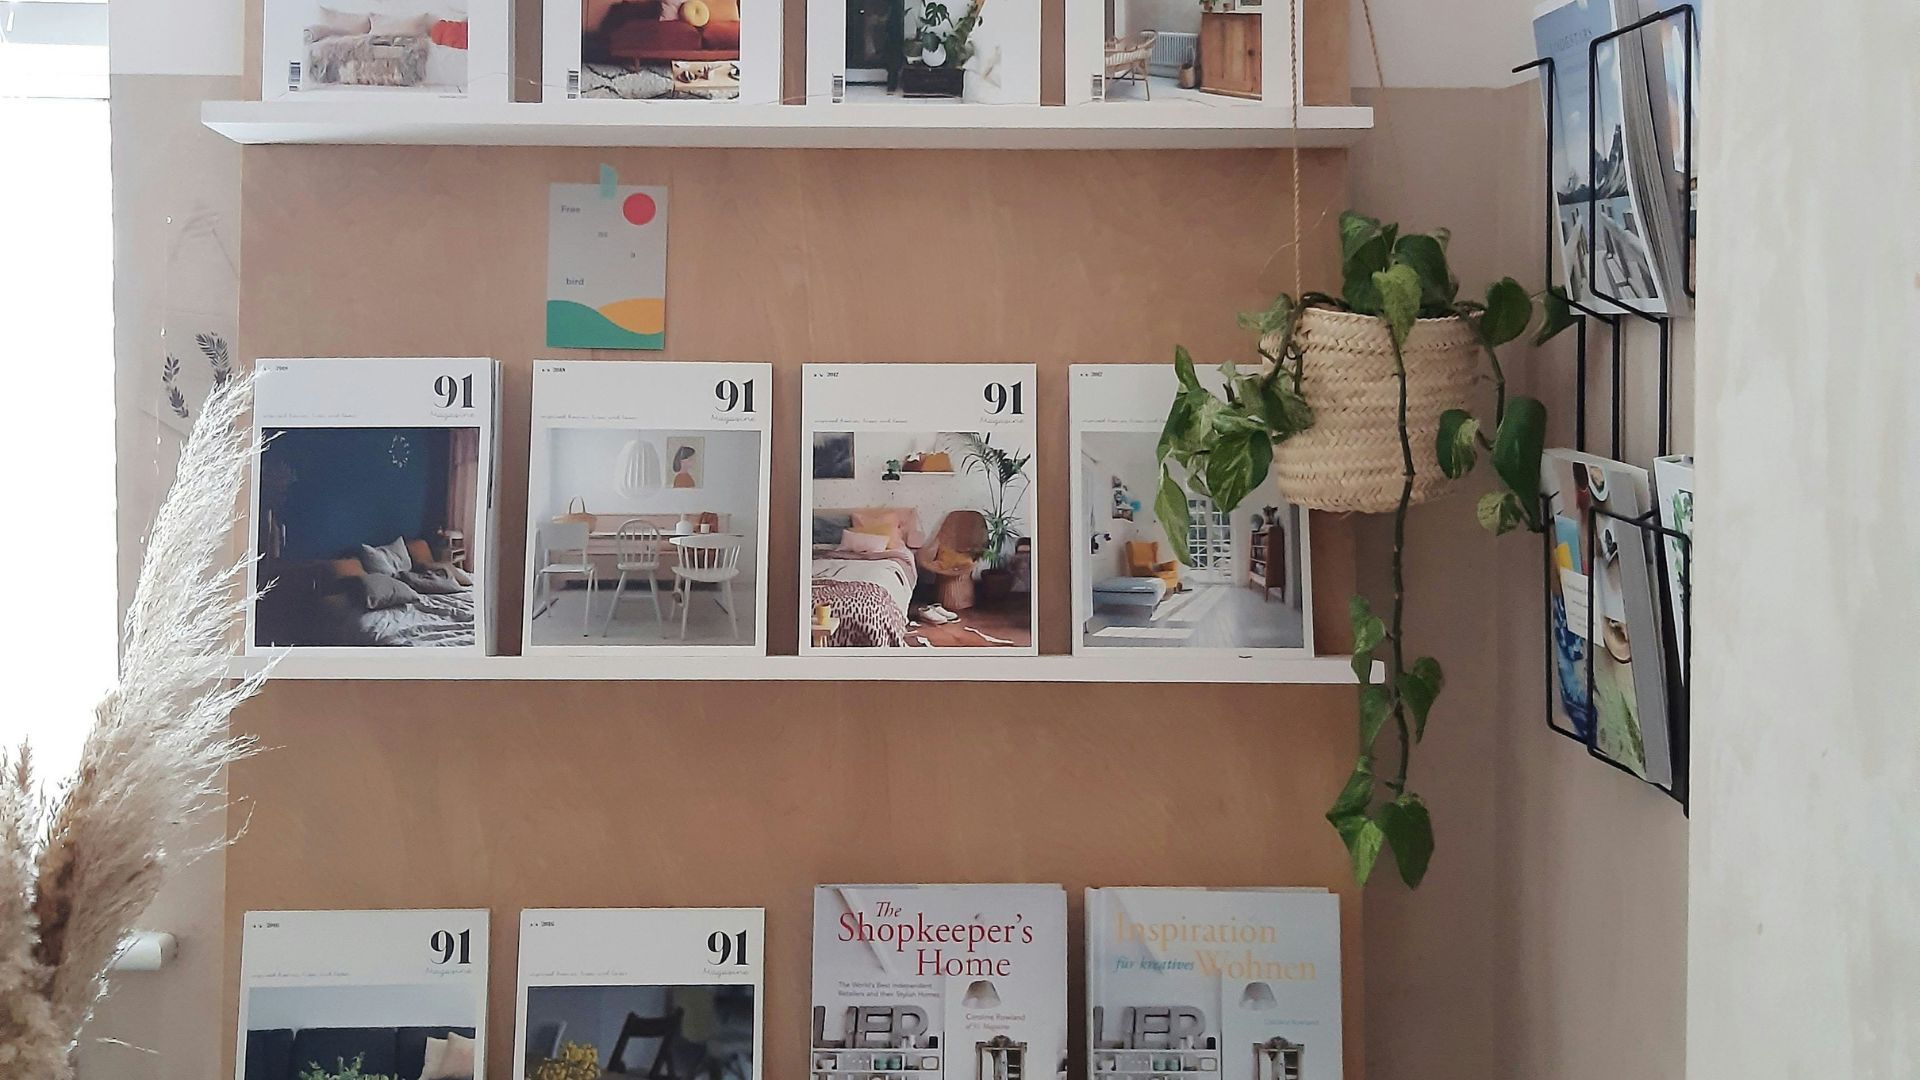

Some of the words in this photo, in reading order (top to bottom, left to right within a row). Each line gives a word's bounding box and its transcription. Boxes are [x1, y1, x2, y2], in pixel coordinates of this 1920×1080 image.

[561, 204, 581, 213] Free
[566, 277, 585, 286] bird
[434, 373, 475, 409] 91
[715, 379, 757, 413] 91
[983, 381, 1025, 415] 91
[876, 901, 902, 918] The
[430, 929, 472, 965] 91
[707, 930, 750, 966] 91
[838, 911, 1034, 952] Shopkeeper's
[1113, 911, 1278, 951] Inspiration
[916, 948, 1012, 976] Home
[1113, 956, 1134, 973] für
[1139, 955, 1196, 972] kreatives
[1194, 948, 1317, 981] Wohnen
